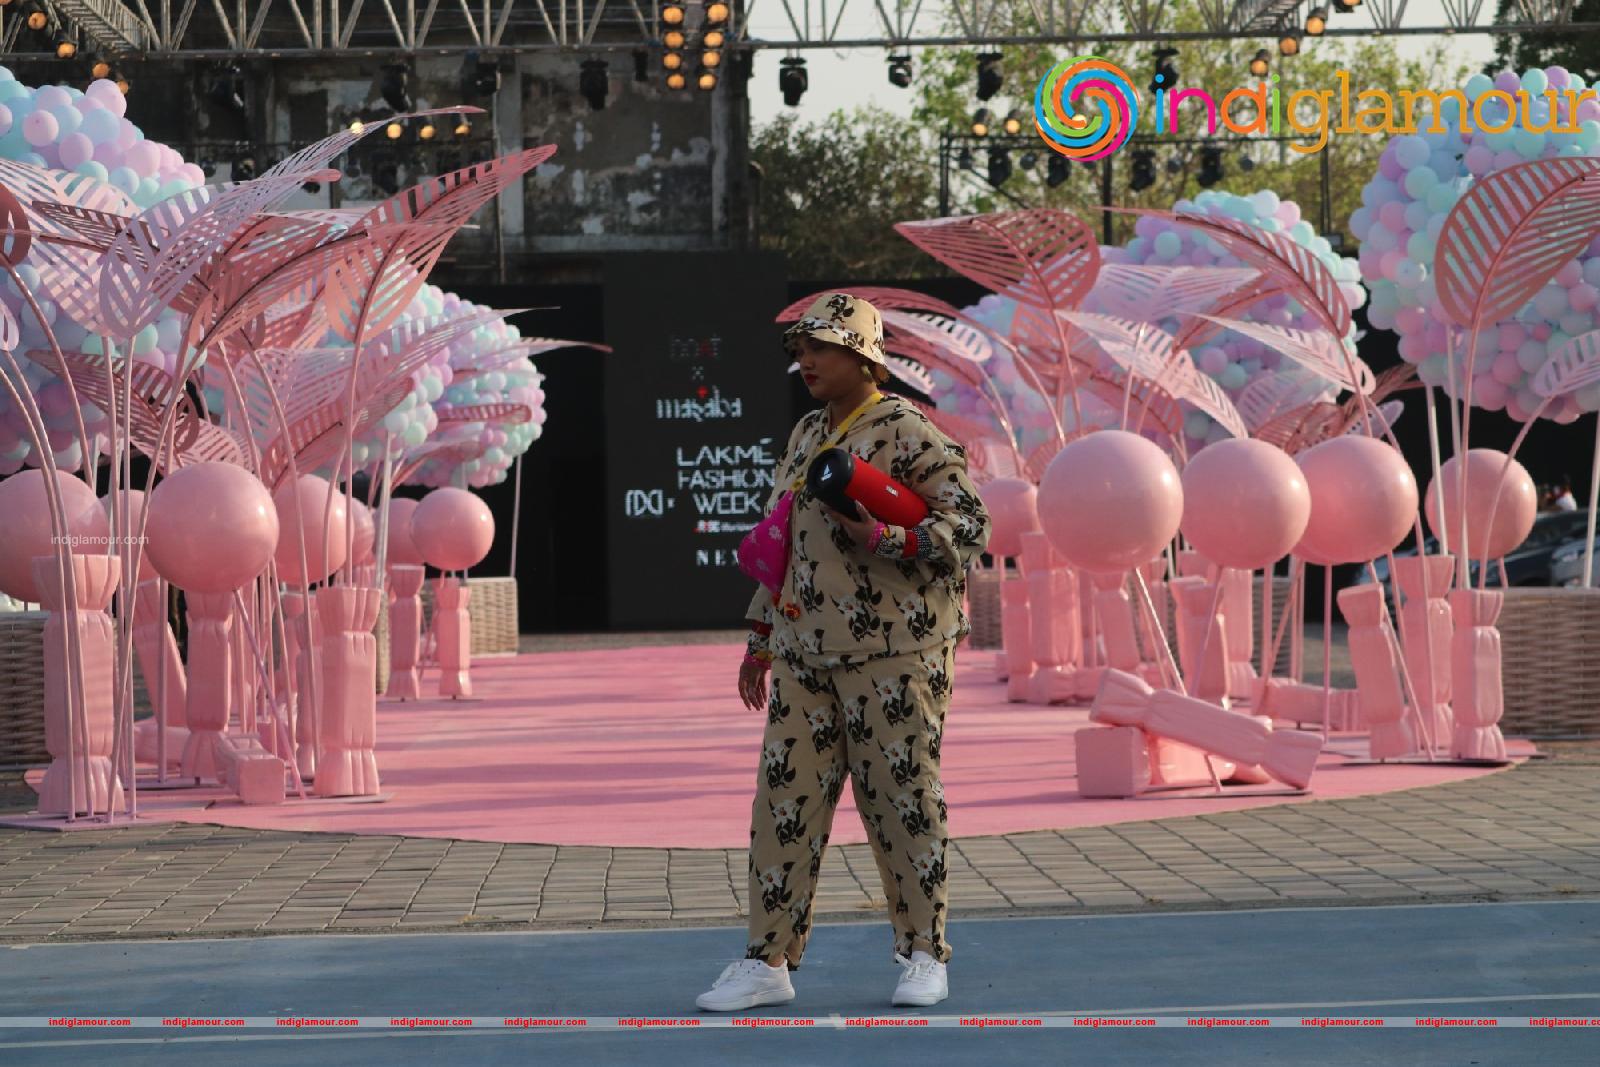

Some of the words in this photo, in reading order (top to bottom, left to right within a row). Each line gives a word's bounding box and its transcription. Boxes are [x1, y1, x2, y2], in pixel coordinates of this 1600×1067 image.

[677, 437, 776, 466] LAKMÉ
[677, 469, 776, 489] FASHION
[692, 491, 761, 514] WEEK
